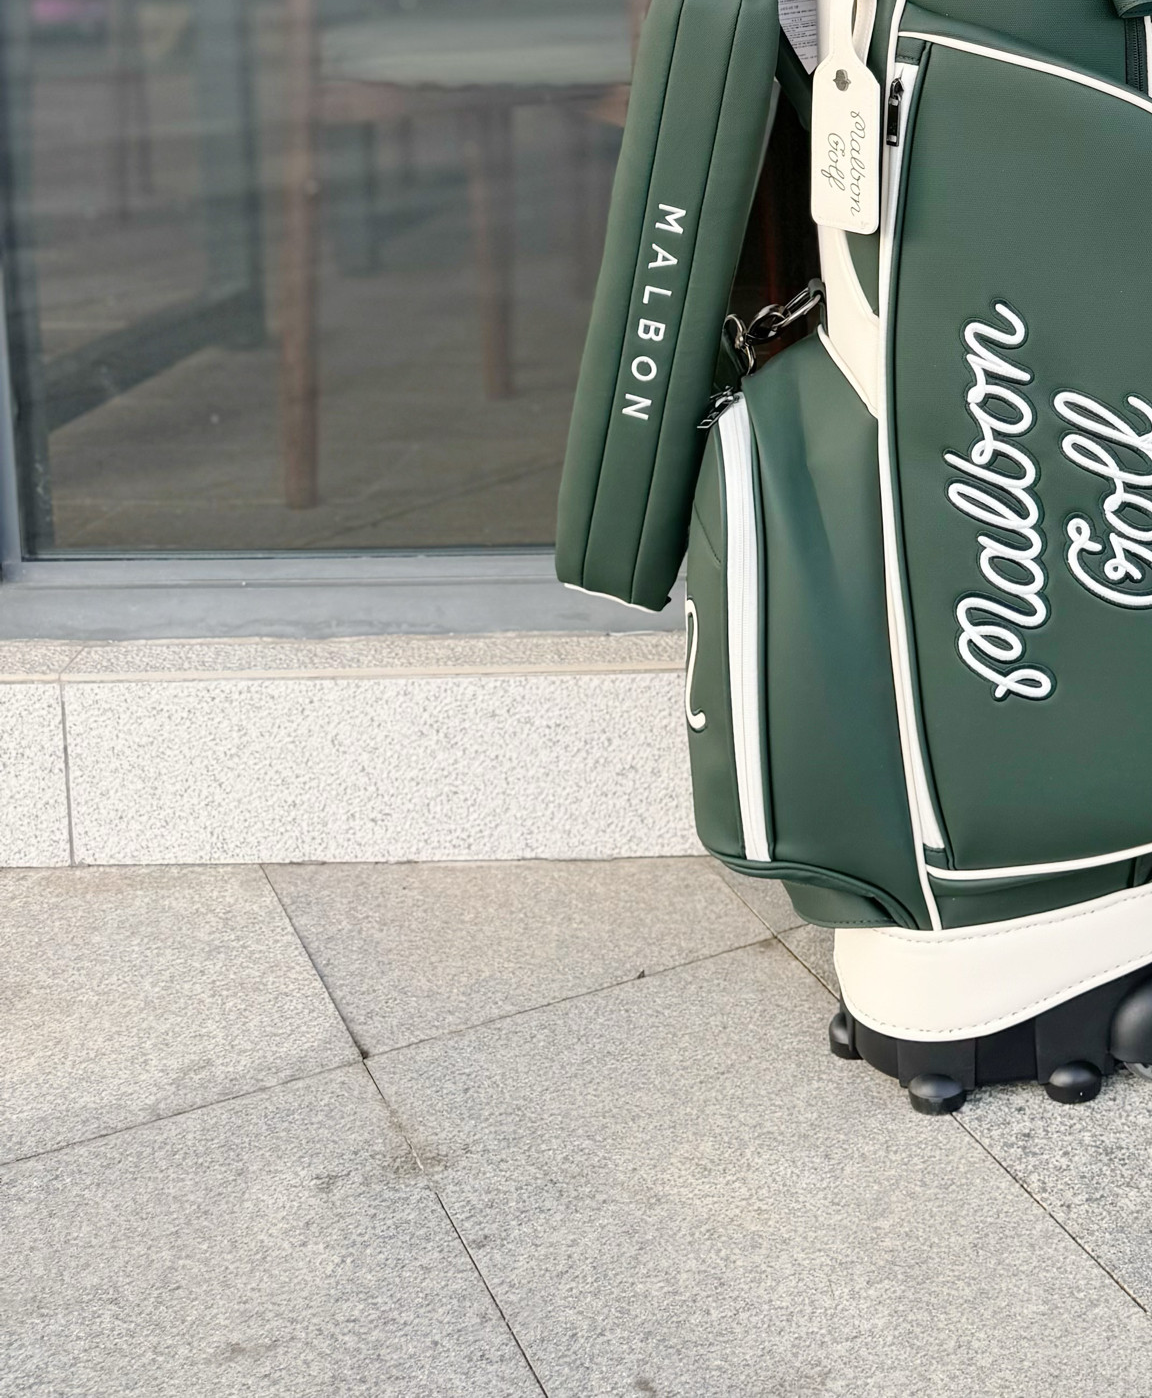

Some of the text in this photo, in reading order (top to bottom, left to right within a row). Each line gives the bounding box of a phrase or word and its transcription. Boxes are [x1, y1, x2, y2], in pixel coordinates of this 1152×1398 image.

[820, 132, 846, 192] Golf
[850, 111, 866, 217] Malbon
[622, 202, 687, 421] MALBON
[944, 301, 1056, 700] Malbon
